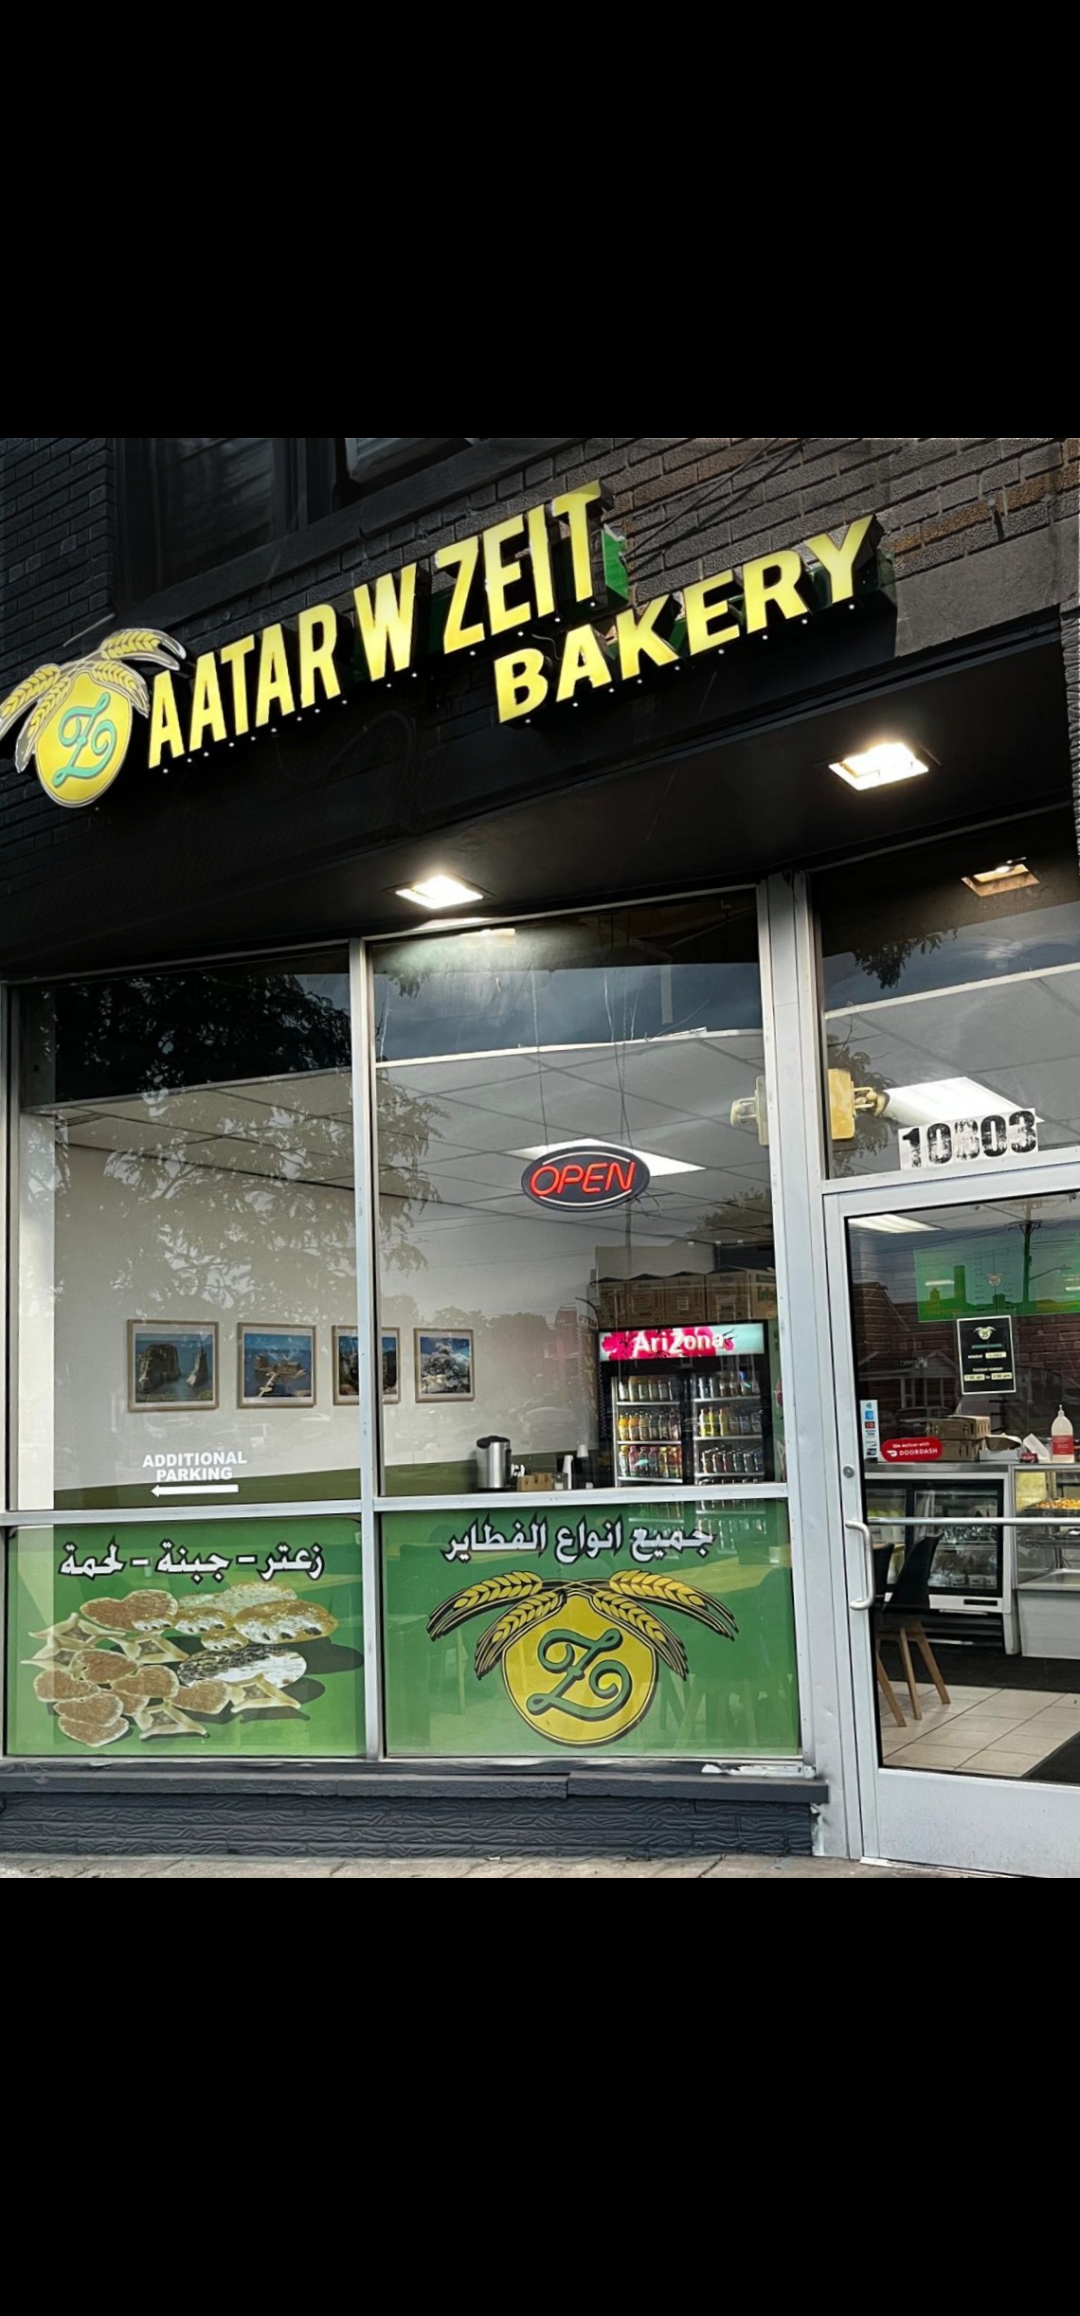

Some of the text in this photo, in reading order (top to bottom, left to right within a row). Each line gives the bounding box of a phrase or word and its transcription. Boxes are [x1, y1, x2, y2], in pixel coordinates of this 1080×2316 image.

[148, 480, 602, 769] AATAR W ZEIT
[494, 514, 876, 723] BAKERY
[529, 1161, 636, 1197] OPEN
[632, 1330, 726, 1358] AriZona
[142, 1451, 248, 1468] ADDITIONAL
[899, 1448, 938, 1456] DOORDASH
[156, 1467, 233, 1482] PARKING
[444, 1516, 715, 1563] جميع انواع الفطاير
[59, 1539, 126, 1579] لحمة
[156, 1540, 231, 1583] جبنة
[259, 1543, 324, 1580] زعتر
